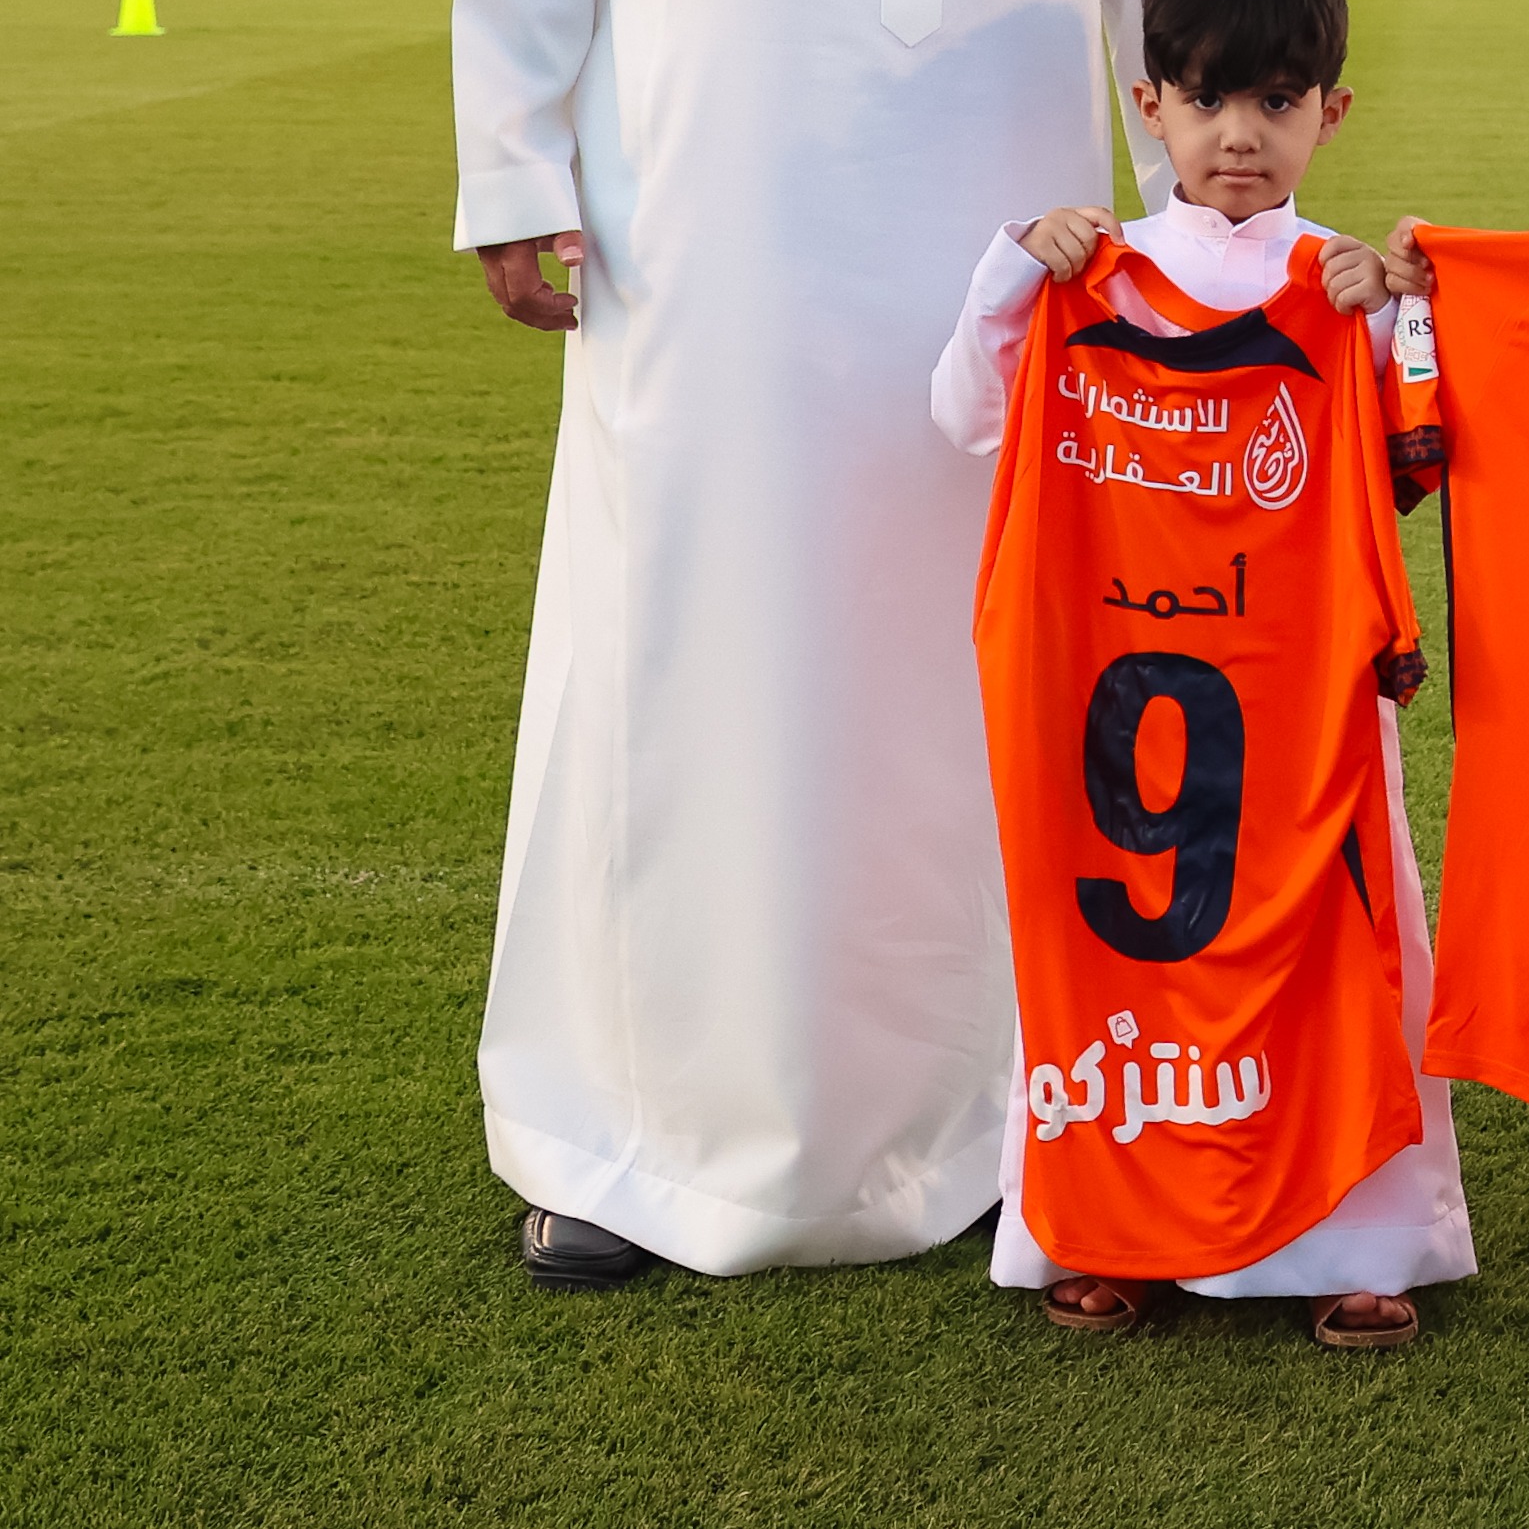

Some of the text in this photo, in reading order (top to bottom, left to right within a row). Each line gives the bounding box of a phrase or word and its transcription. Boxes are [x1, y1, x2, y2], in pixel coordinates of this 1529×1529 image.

[1408, 316, 1434, 337] RS
[1103, 552, 1246, 619] أحمد
[1075, 651, 1245, 963] 9
